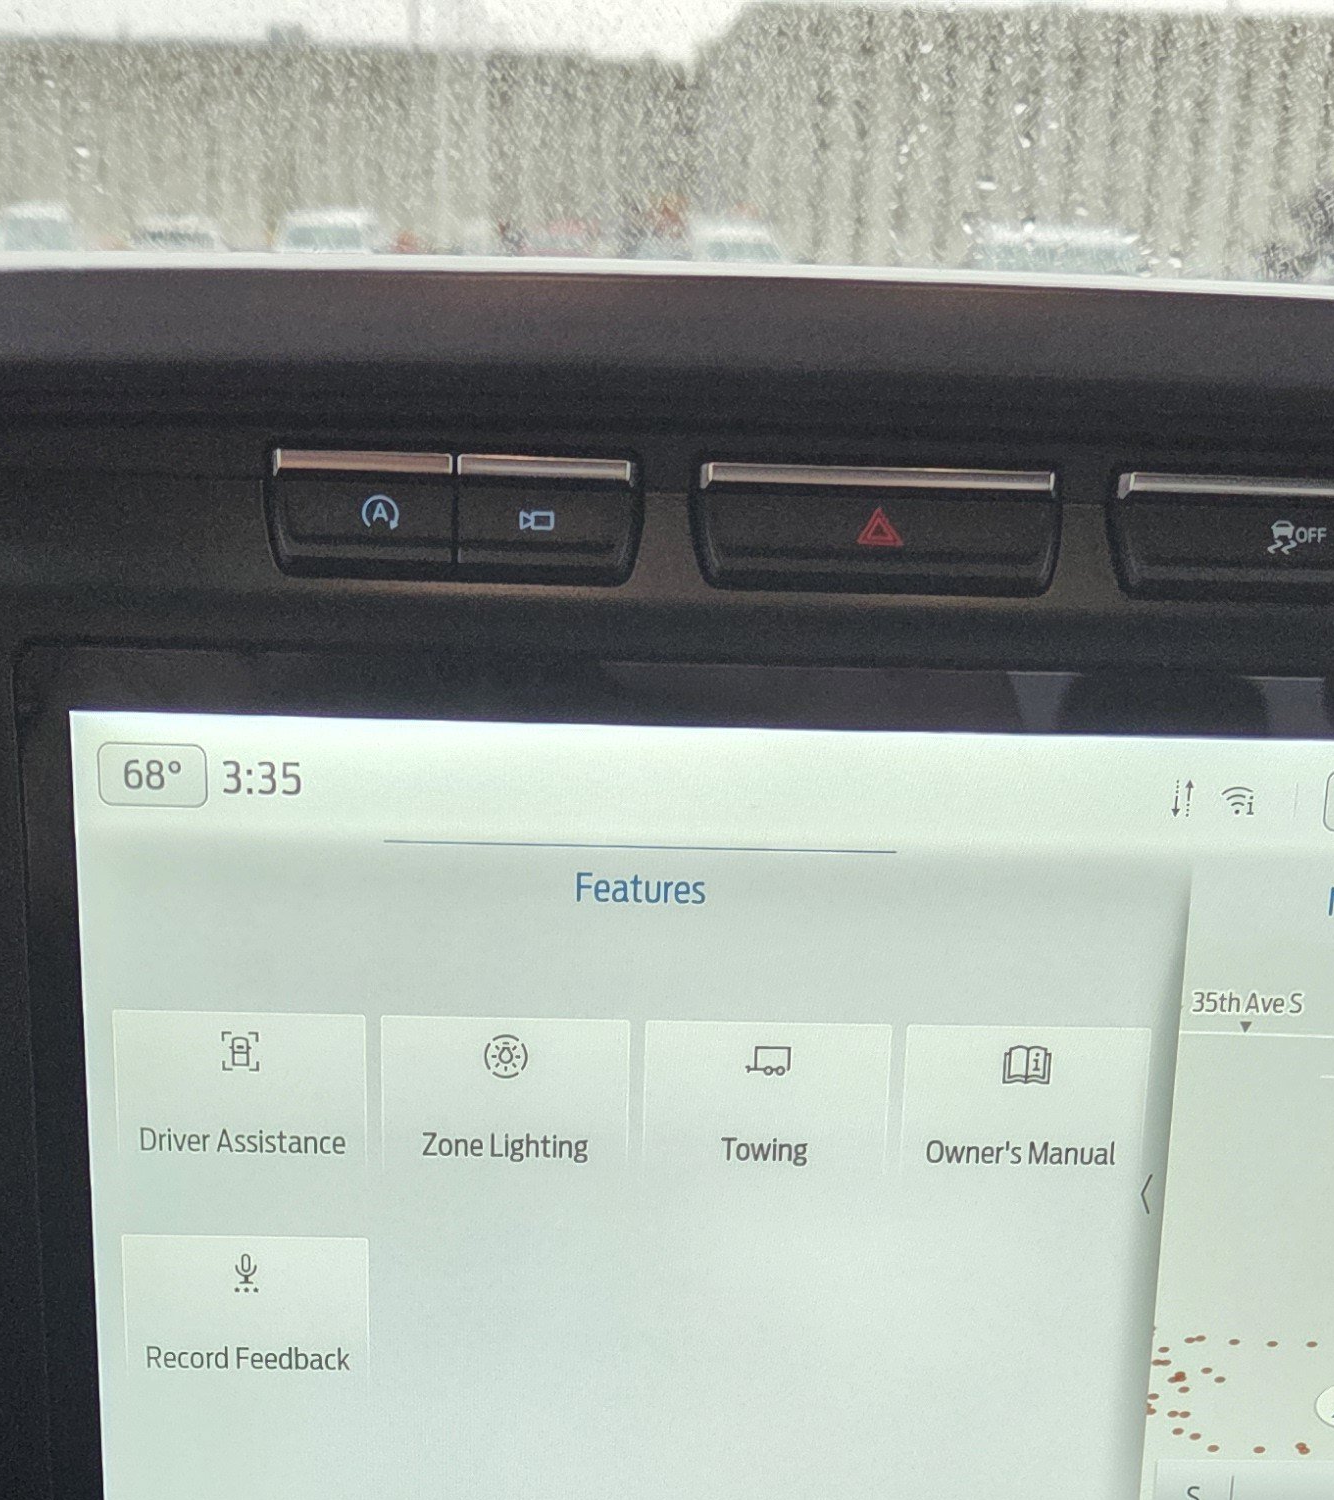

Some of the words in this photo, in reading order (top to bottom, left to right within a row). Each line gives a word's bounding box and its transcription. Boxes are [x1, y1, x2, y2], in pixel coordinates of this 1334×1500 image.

[1293, 526, 1328, 546] OFF
[221, 760, 303, 796] 3:35
[575, 872, 707, 905] Features
[1192, 992, 1242, 1013] 35th
[1245, 994, 1286, 1013] Ave
[1288, 995, 1303, 1014] S
[140, 1128, 210, 1152] Driver
[216, 1129, 346, 1155] Assistance
[422, 1132, 484, 1157] Zone
[490, 1133, 588, 1163] Lighting
[722, 1137, 808, 1167] Towing
[925, 1140, 1022, 1165] Owner's
[1028, 1142, 1116, 1166] Manual
[146, 1346, 229, 1369] Record
[236, 1347, 350, 1371] Feedback
